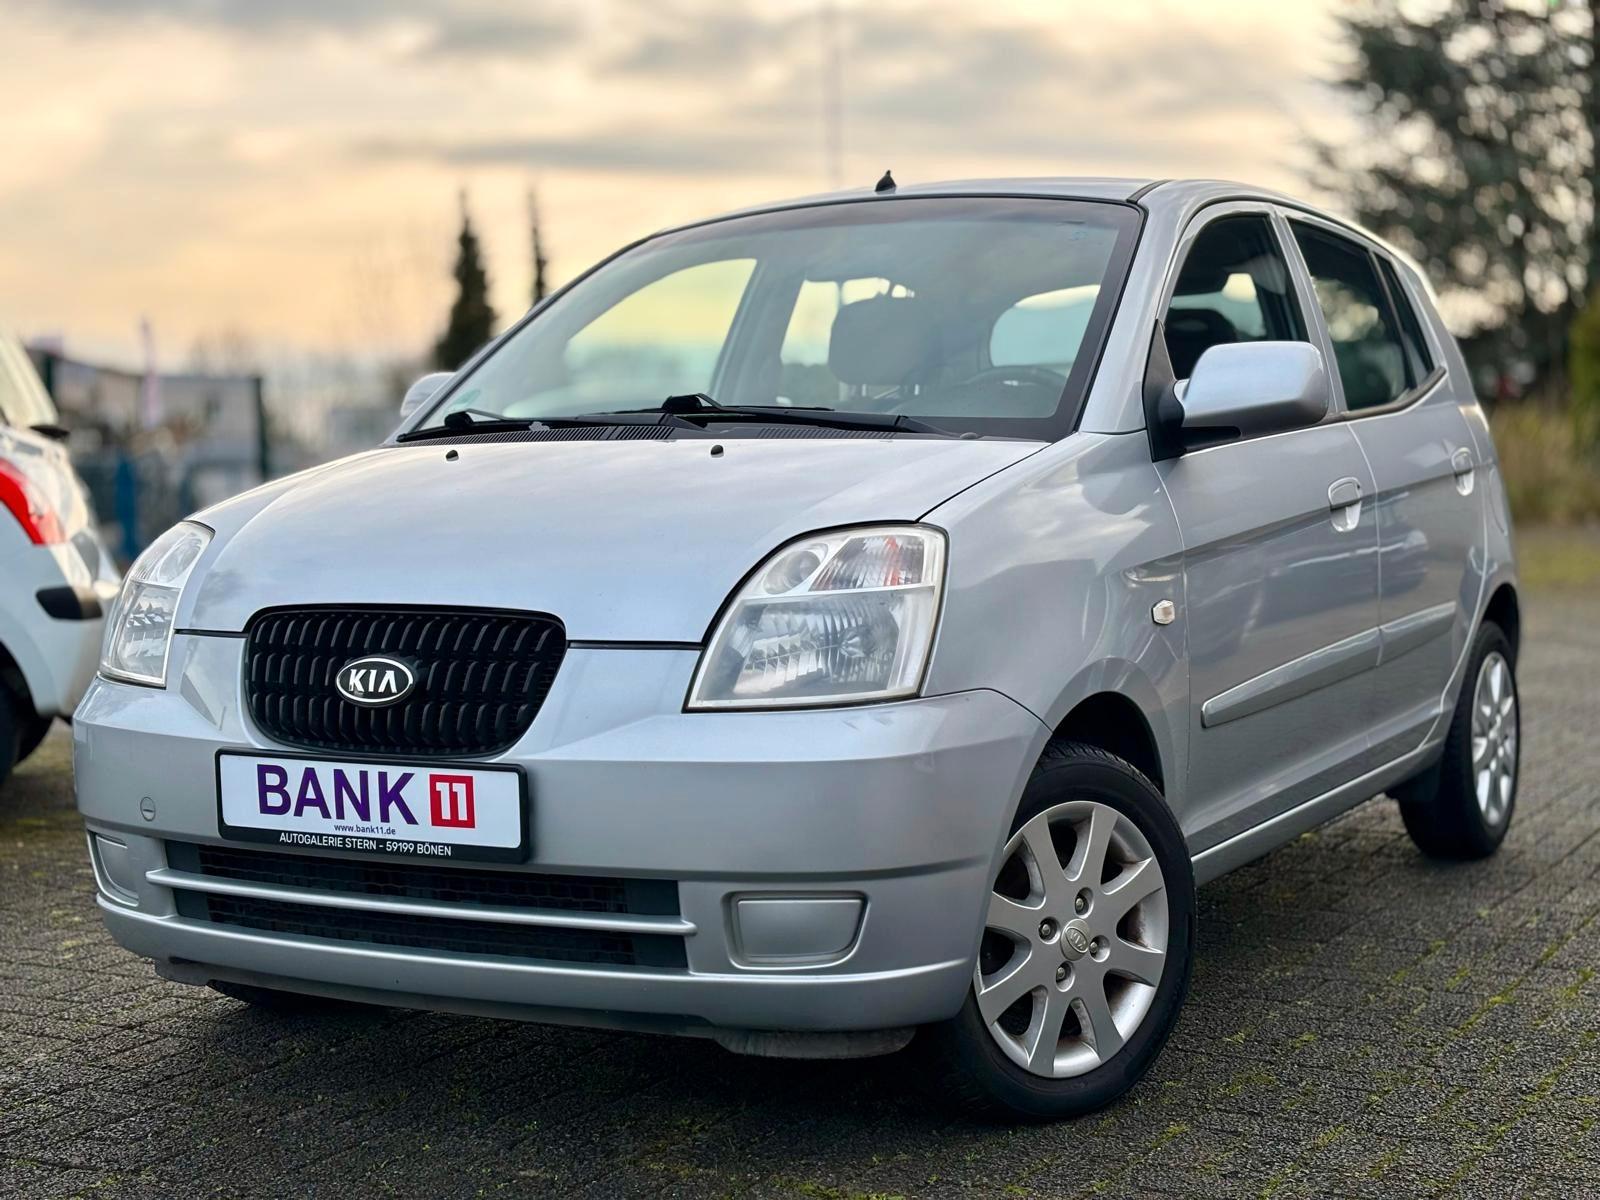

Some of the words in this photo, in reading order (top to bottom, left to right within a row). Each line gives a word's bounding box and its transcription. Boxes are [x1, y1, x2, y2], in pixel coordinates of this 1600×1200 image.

[349, 669, 398, 693] KIA
[256, 763, 419, 825] BANK
[434, 780, 470, 822] 11
[333, 824, 396, 835] www.bank11.de
[279, 832, 344, 848] AUTOGALERIE
[345, 837, 377, 850] STERN
[385, 841, 415, 853] 59199
[416, 842, 452, 857] BÖNEN
